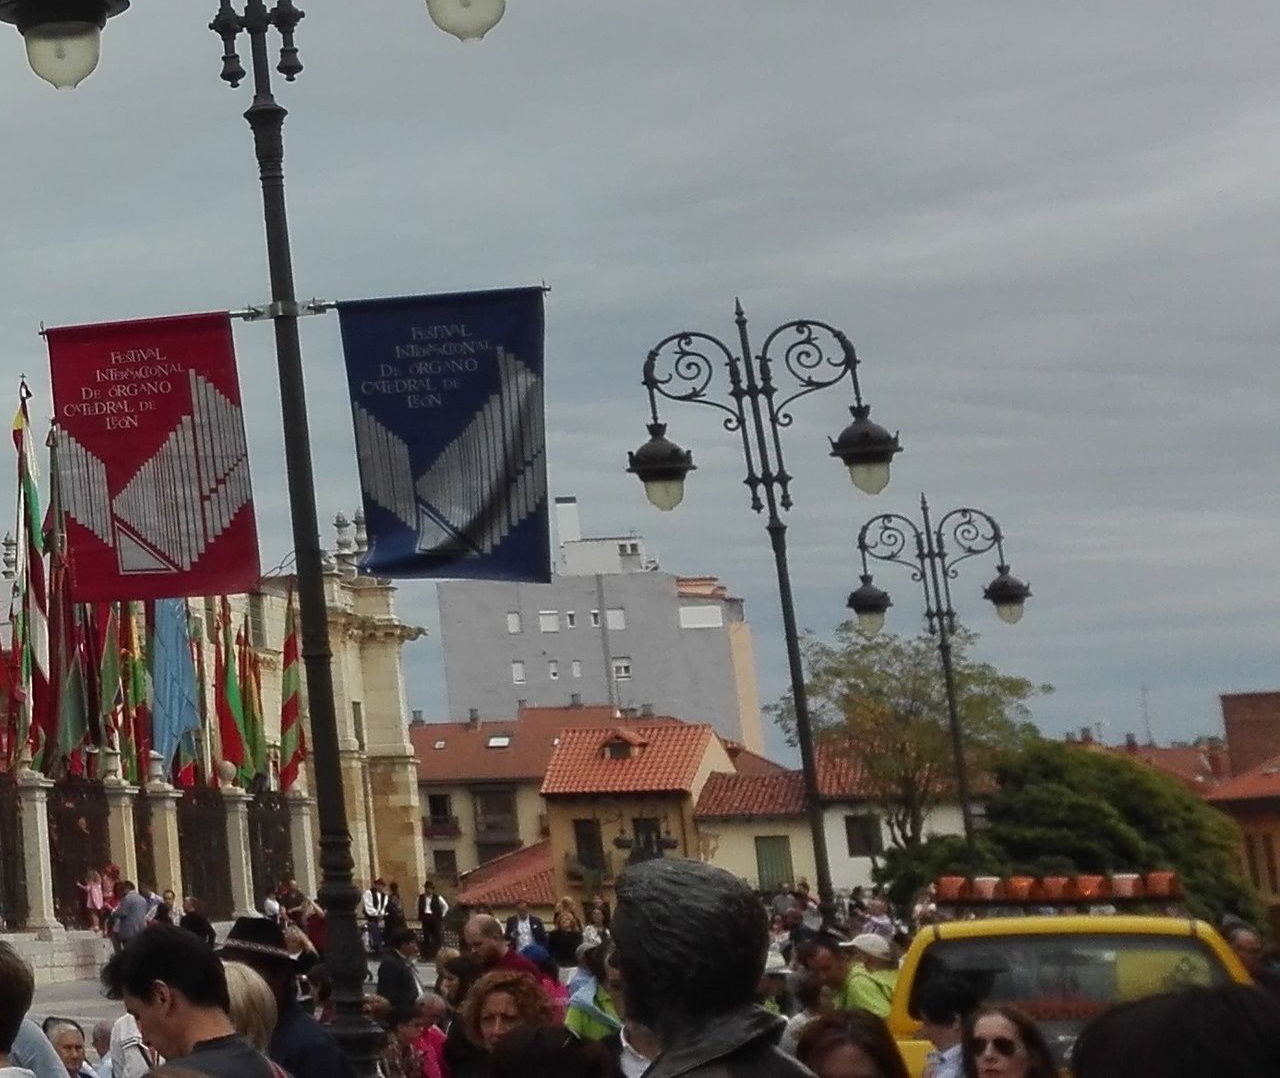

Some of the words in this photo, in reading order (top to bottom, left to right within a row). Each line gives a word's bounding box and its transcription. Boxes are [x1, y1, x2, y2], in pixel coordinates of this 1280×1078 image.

[410, 324, 472, 340] FESTIVAL
[110, 348, 166, 364] FESTIVAL
[96, 362, 185, 382] INTERNACIONAL
[81, 387, 100, 400] DE
[361, 378, 438, 395] CATEDRAL
[63, 400, 134, 417] CATEDRAL
[140, 401, 157, 412] DE
